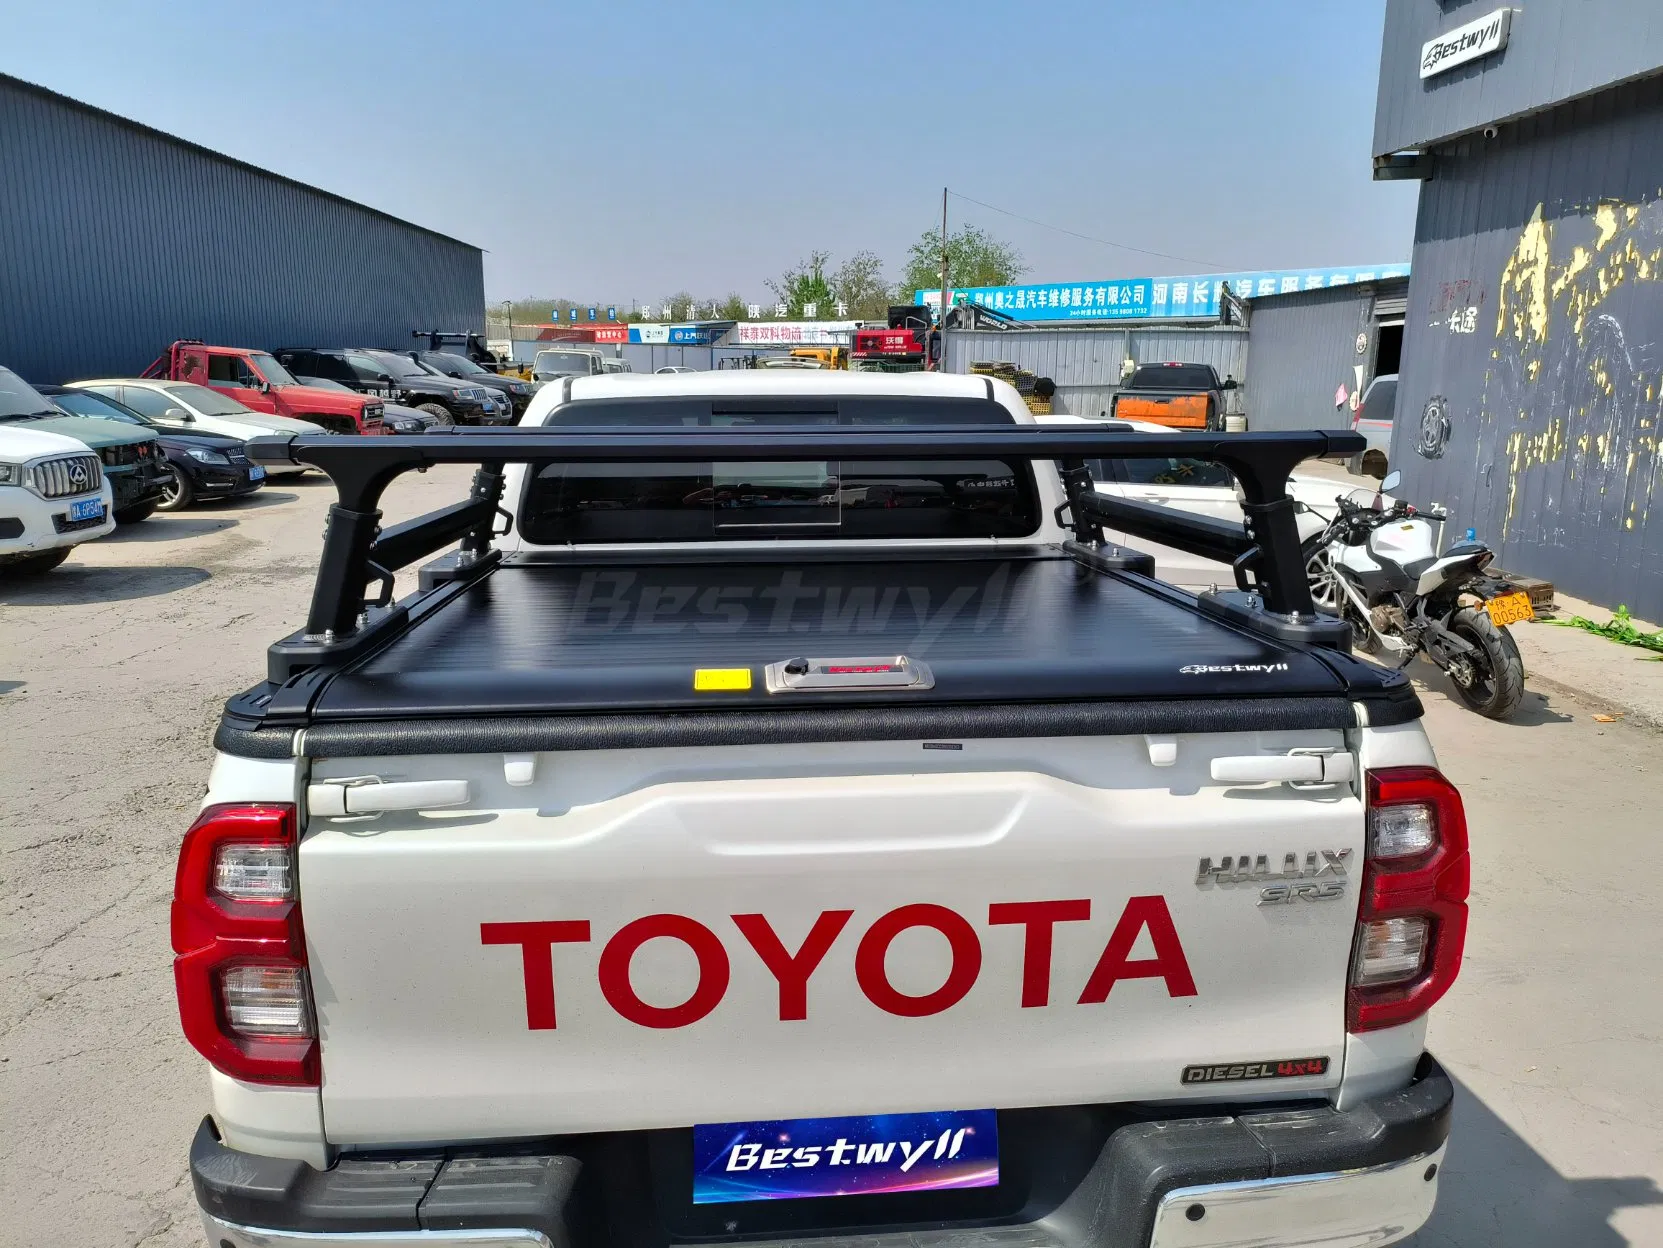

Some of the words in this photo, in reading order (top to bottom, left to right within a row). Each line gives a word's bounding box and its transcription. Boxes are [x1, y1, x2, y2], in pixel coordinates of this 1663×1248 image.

[1431, 19, 1500, 61] Bestwyll
[1493, 604, 1531, 625] 00563
[1195, 848, 1352, 885] HILUX
[1257, 881, 1347, 907] SR5
[480, 895, 1198, 1030] TOYOTA
[1187, 1065, 1274, 1081] DIESEL
[725, 1129, 966, 1173] Bestwyll
